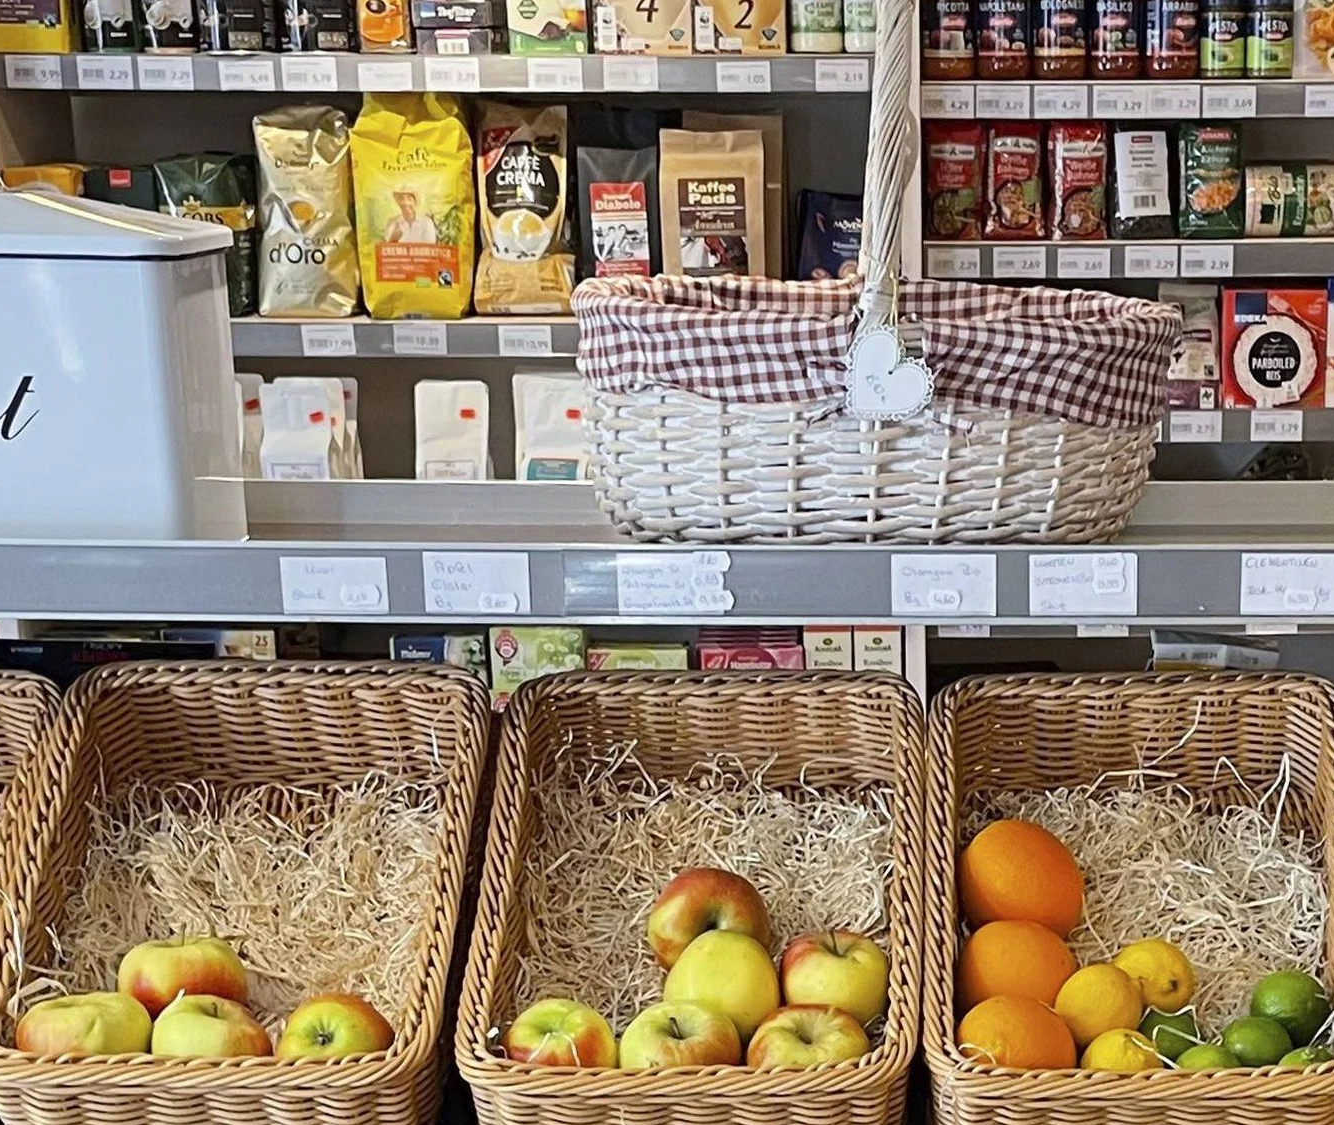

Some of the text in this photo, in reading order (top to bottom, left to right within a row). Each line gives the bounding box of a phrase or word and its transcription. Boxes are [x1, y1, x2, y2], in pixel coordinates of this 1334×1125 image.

[733, 0, 753, 29] 2
[1208, 20, 1238, 33] PESTO
[496, 171, 546, 187] CREMA
[687, 181, 736, 193] Kaffee
[595, 199, 642, 211] Diabolo
[687, 192, 737, 205] Pads
[268, 243, 326, 265] d'Oro
[1234, 314, 1268, 324] EDEKA
[1252, 358, 1296, 371] PARBOILED
